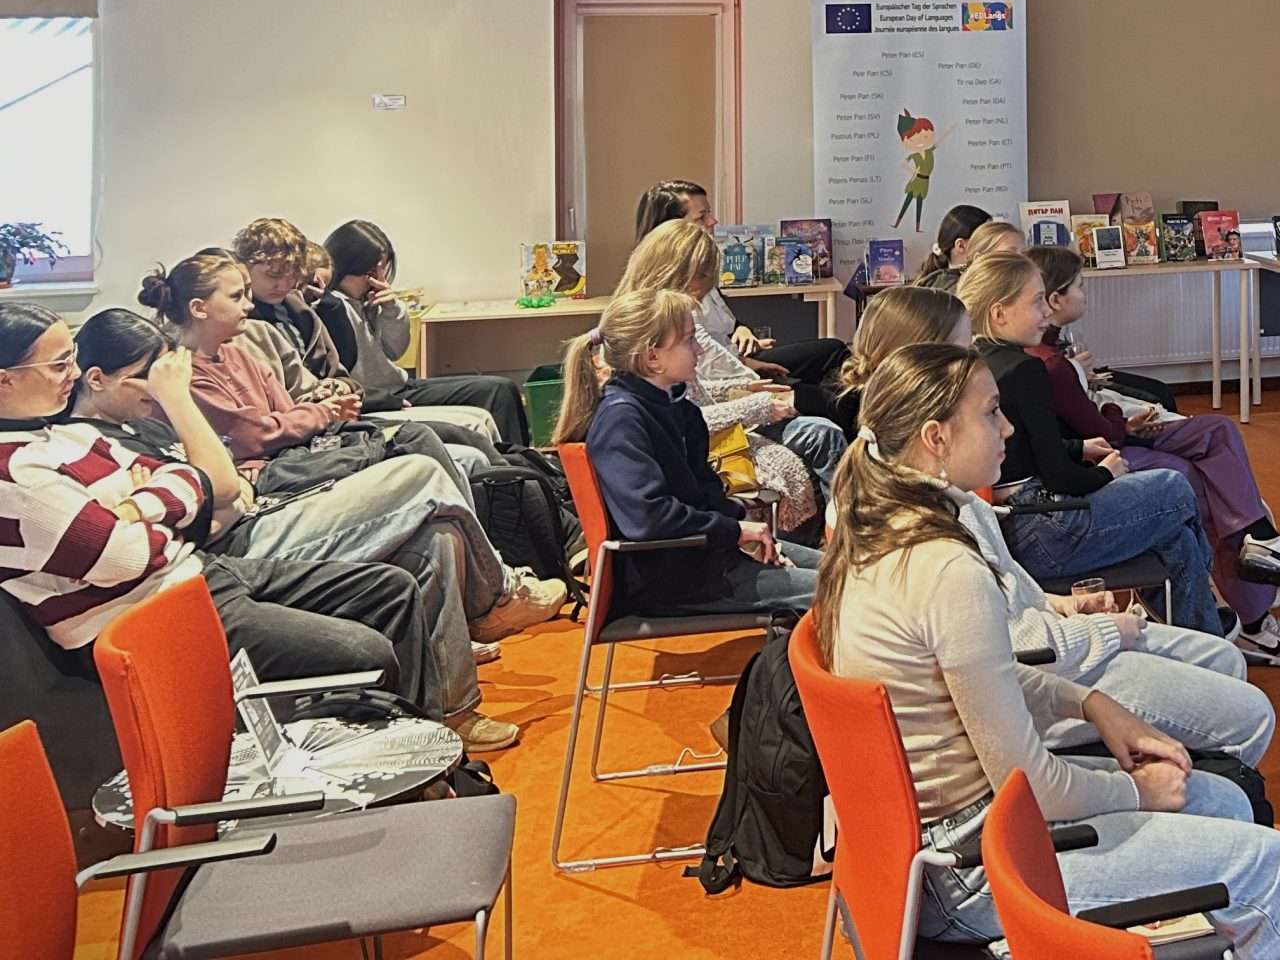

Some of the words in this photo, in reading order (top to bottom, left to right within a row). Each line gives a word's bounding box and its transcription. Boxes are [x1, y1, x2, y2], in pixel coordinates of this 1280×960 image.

[911, 3, 921, 11] Tag
[932, 3, 957, 11] Sprachen
[925, 14, 953, 22] Languages
[896, 26, 928, 34] européenne
